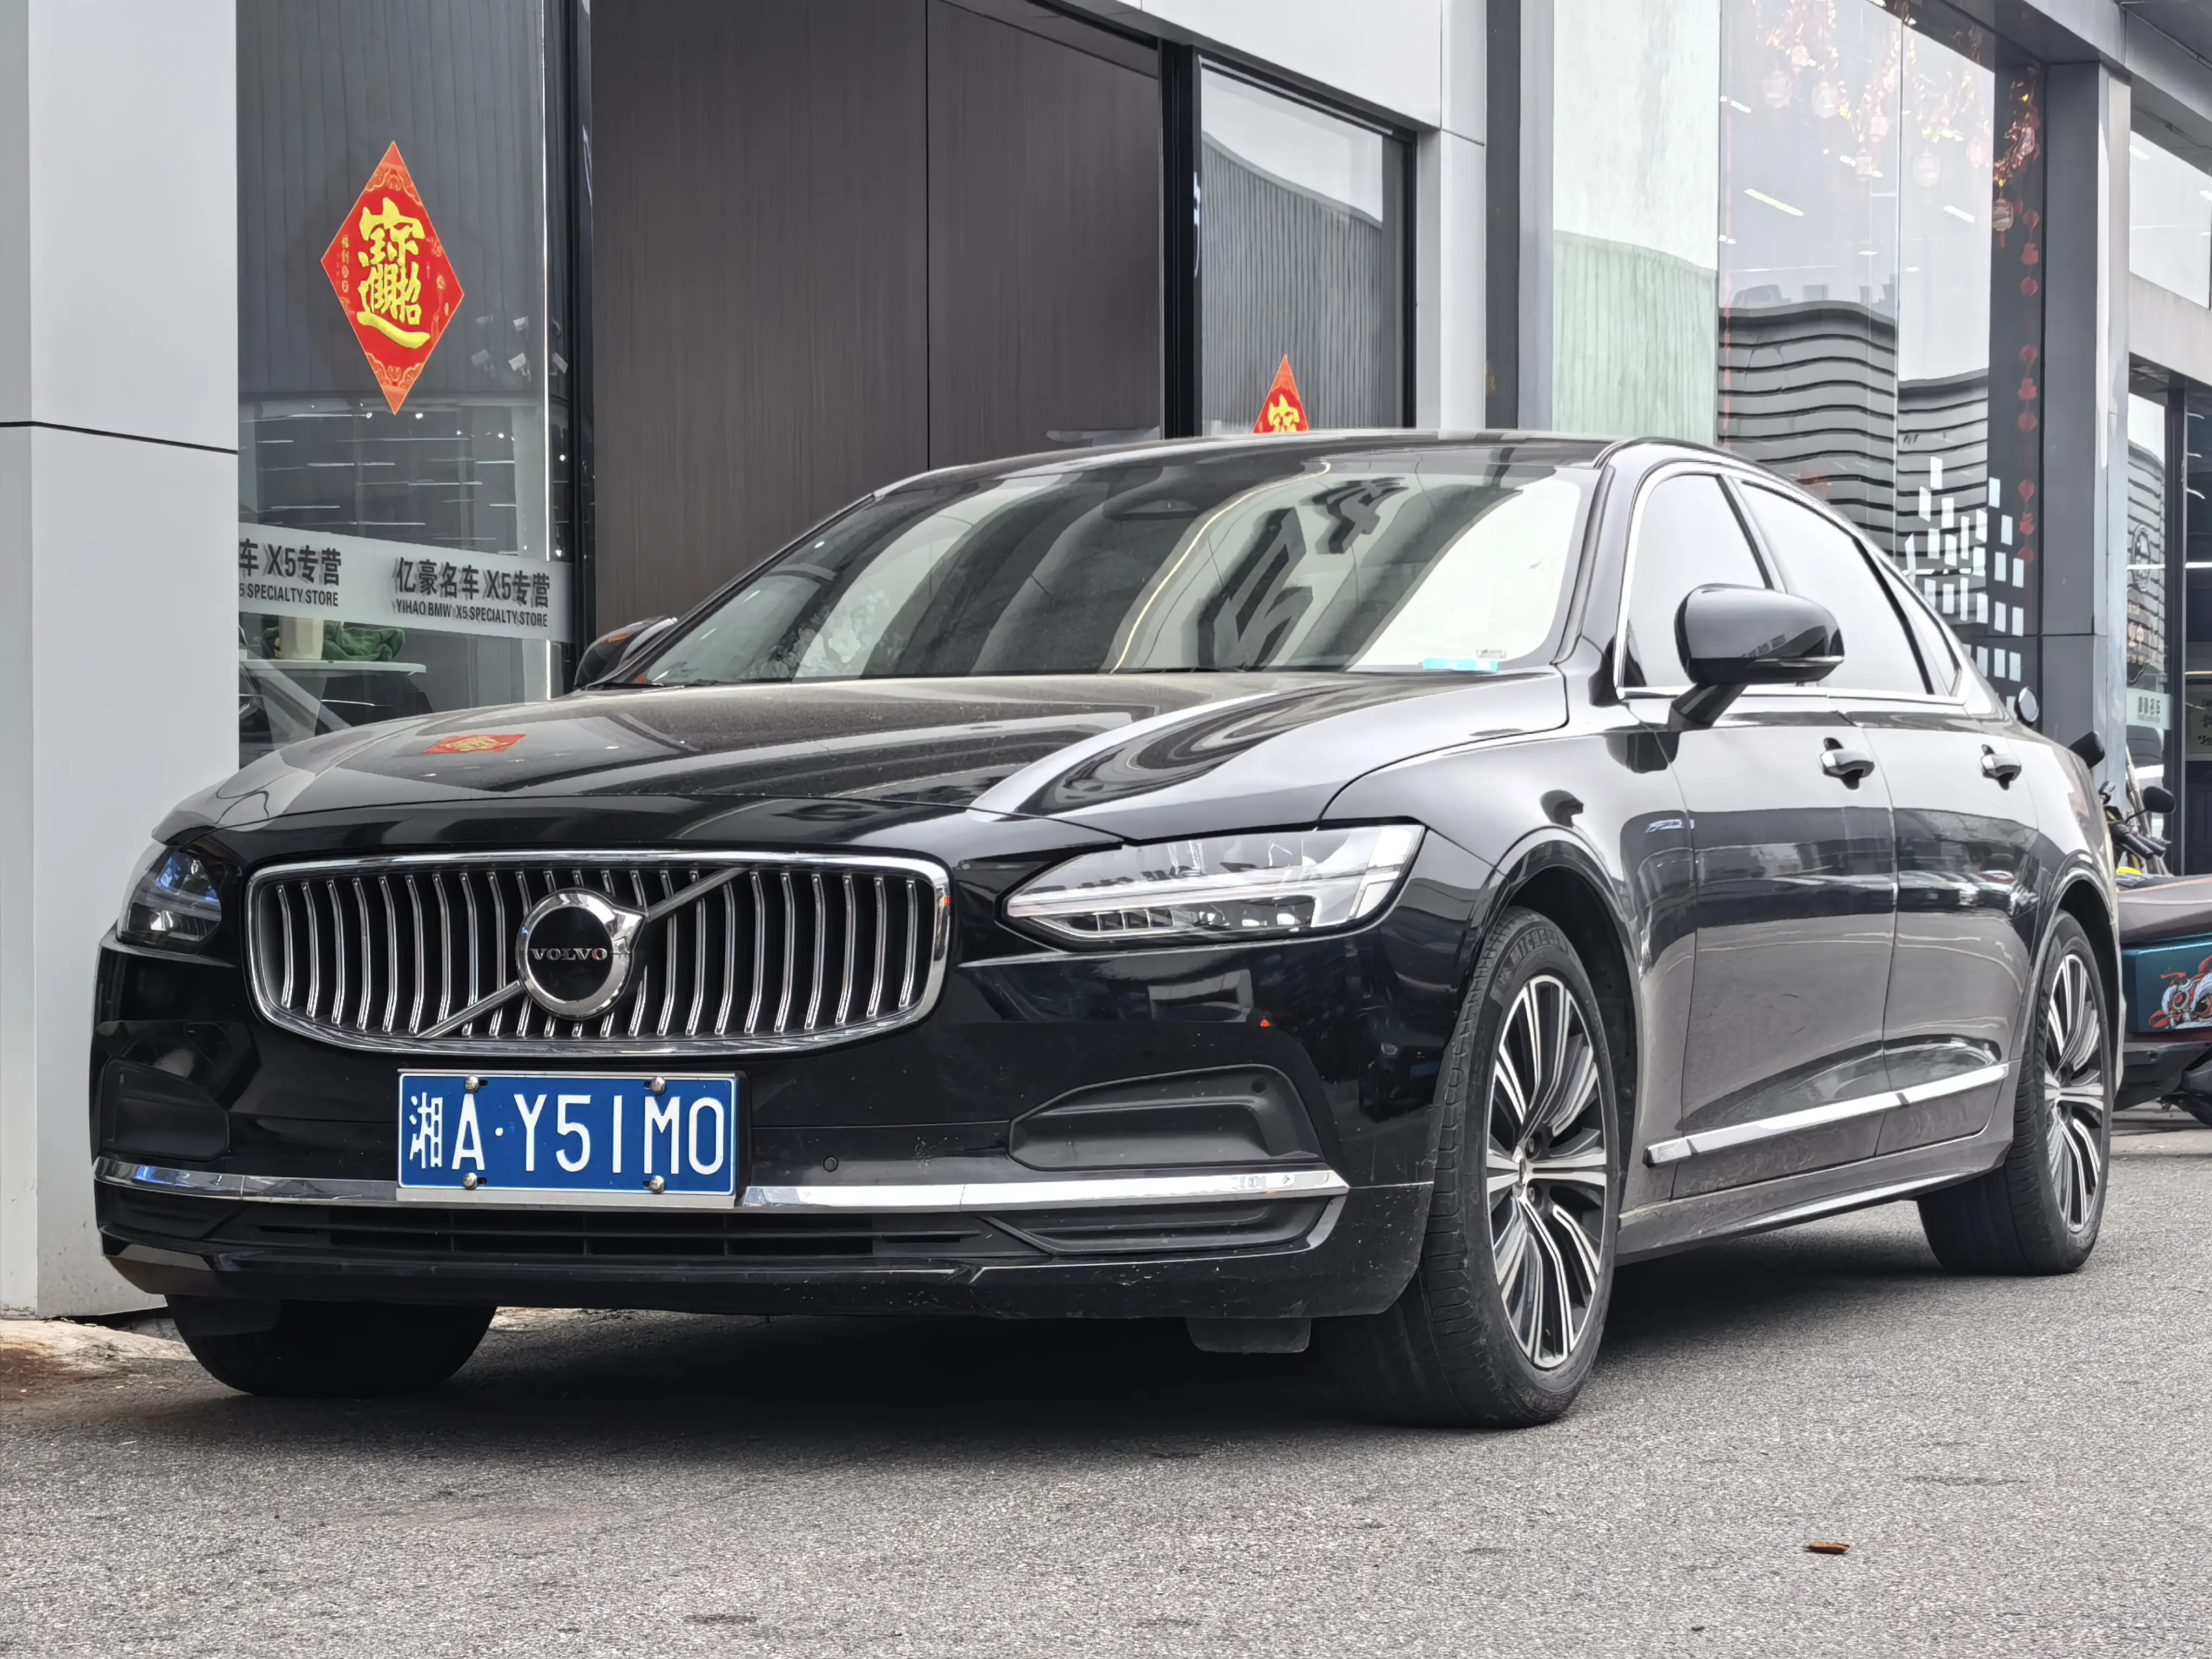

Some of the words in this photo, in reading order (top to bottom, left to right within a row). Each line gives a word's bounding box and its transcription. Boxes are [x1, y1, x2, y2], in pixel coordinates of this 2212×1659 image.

[247, 583, 303, 603] SPECIALTY
[305, 589, 339, 607] STORE
[396, 598, 426, 615] YIHAO
[428, 601, 452, 618] BMW
[456, 605, 468, 619] X5
[469, 606, 518, 624] SPECIALTY
[519, 611, 548, 627] STORE
[529, 947, 608, 961] VOLVO
